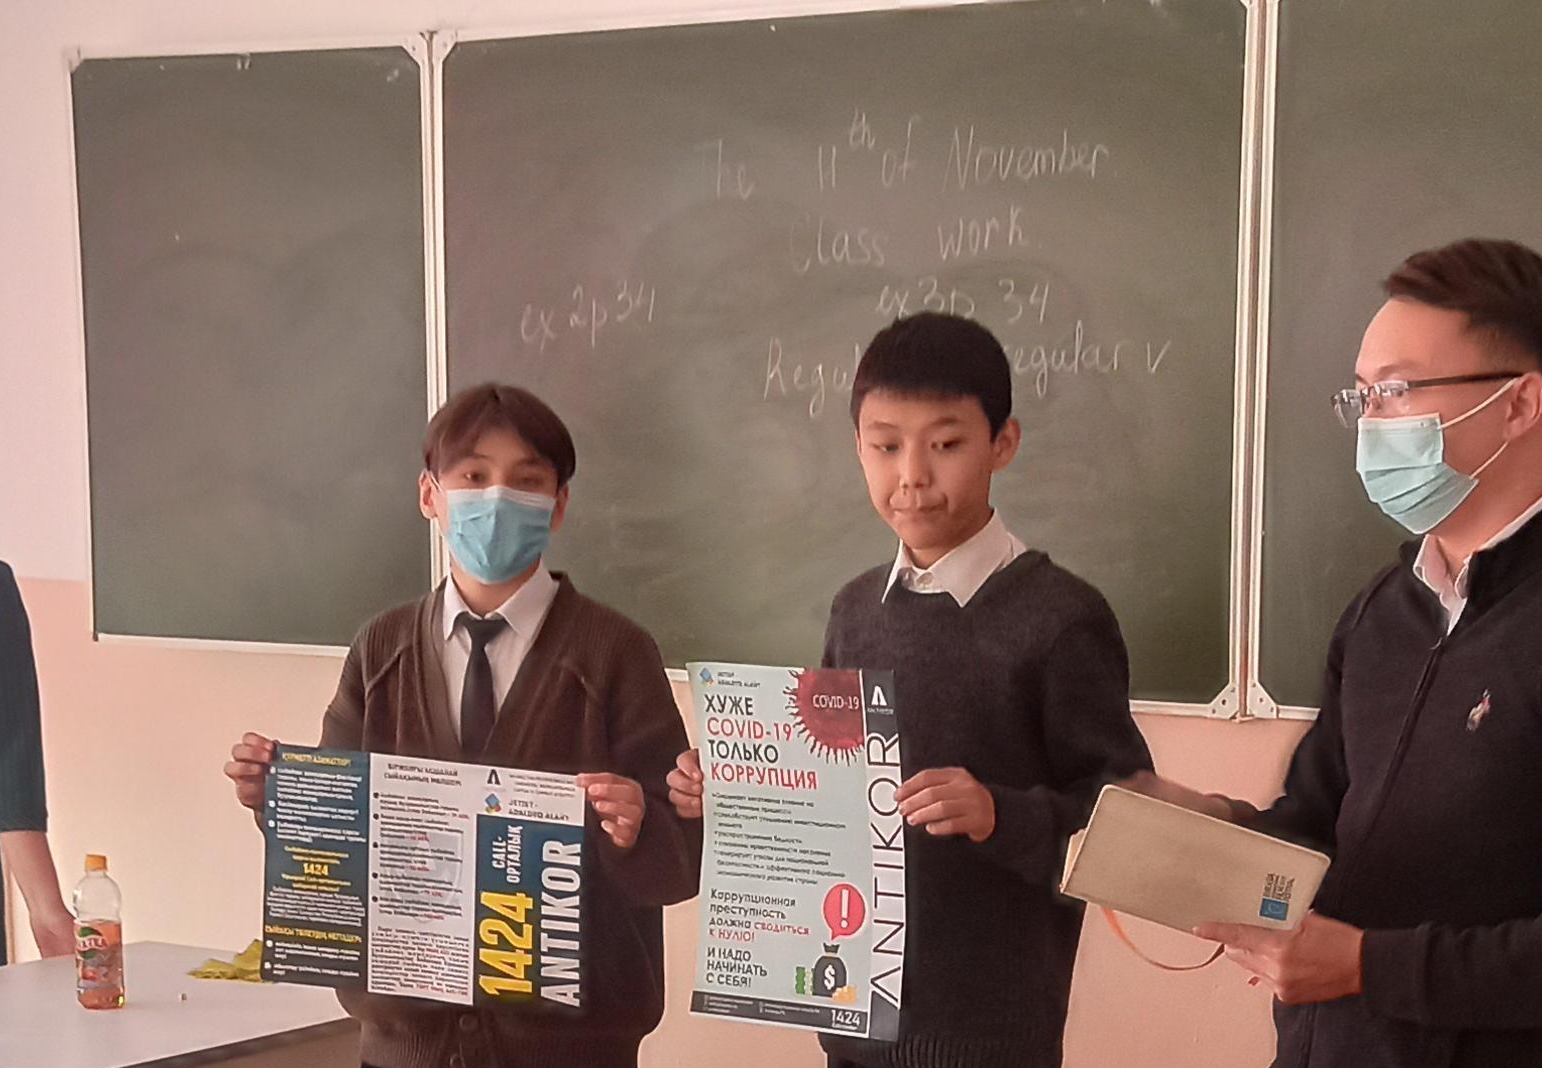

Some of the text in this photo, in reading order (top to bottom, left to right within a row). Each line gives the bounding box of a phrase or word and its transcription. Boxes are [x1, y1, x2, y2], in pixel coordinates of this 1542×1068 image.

[789, 213, 887, 273] Class
[704, 694, 753, 715] ХУЖЕ
[812, 694, 859, 710] COVID-19
[708, 717, 793, 741] COVID-19
[708, 739, 779, 763] ТОЛЬКО
[711, 763, 817, 790] КОРРУПЦИЯ
[491, 836, 507, 869] CALL-
[303, 863, 329, 875] 1424
[867, 733, 904, 1005] ANTIKOR
[710, 904, 786, 919] преступность
[540, 839, 582, 1008] ANTIKOR
[709, 917, 809, 935] должна сводиться
[479, 891, 534, 996] 1424
[718, 929, 755, 941] НУЛЮ!
[707, 947, 751, 962] И НАДО
[707, 959, 768, 977] НАЧИНАТЬ
[706, 972, 752, 988] С СЕБЯ!
[831, 1009, 860, 1025] 1424
